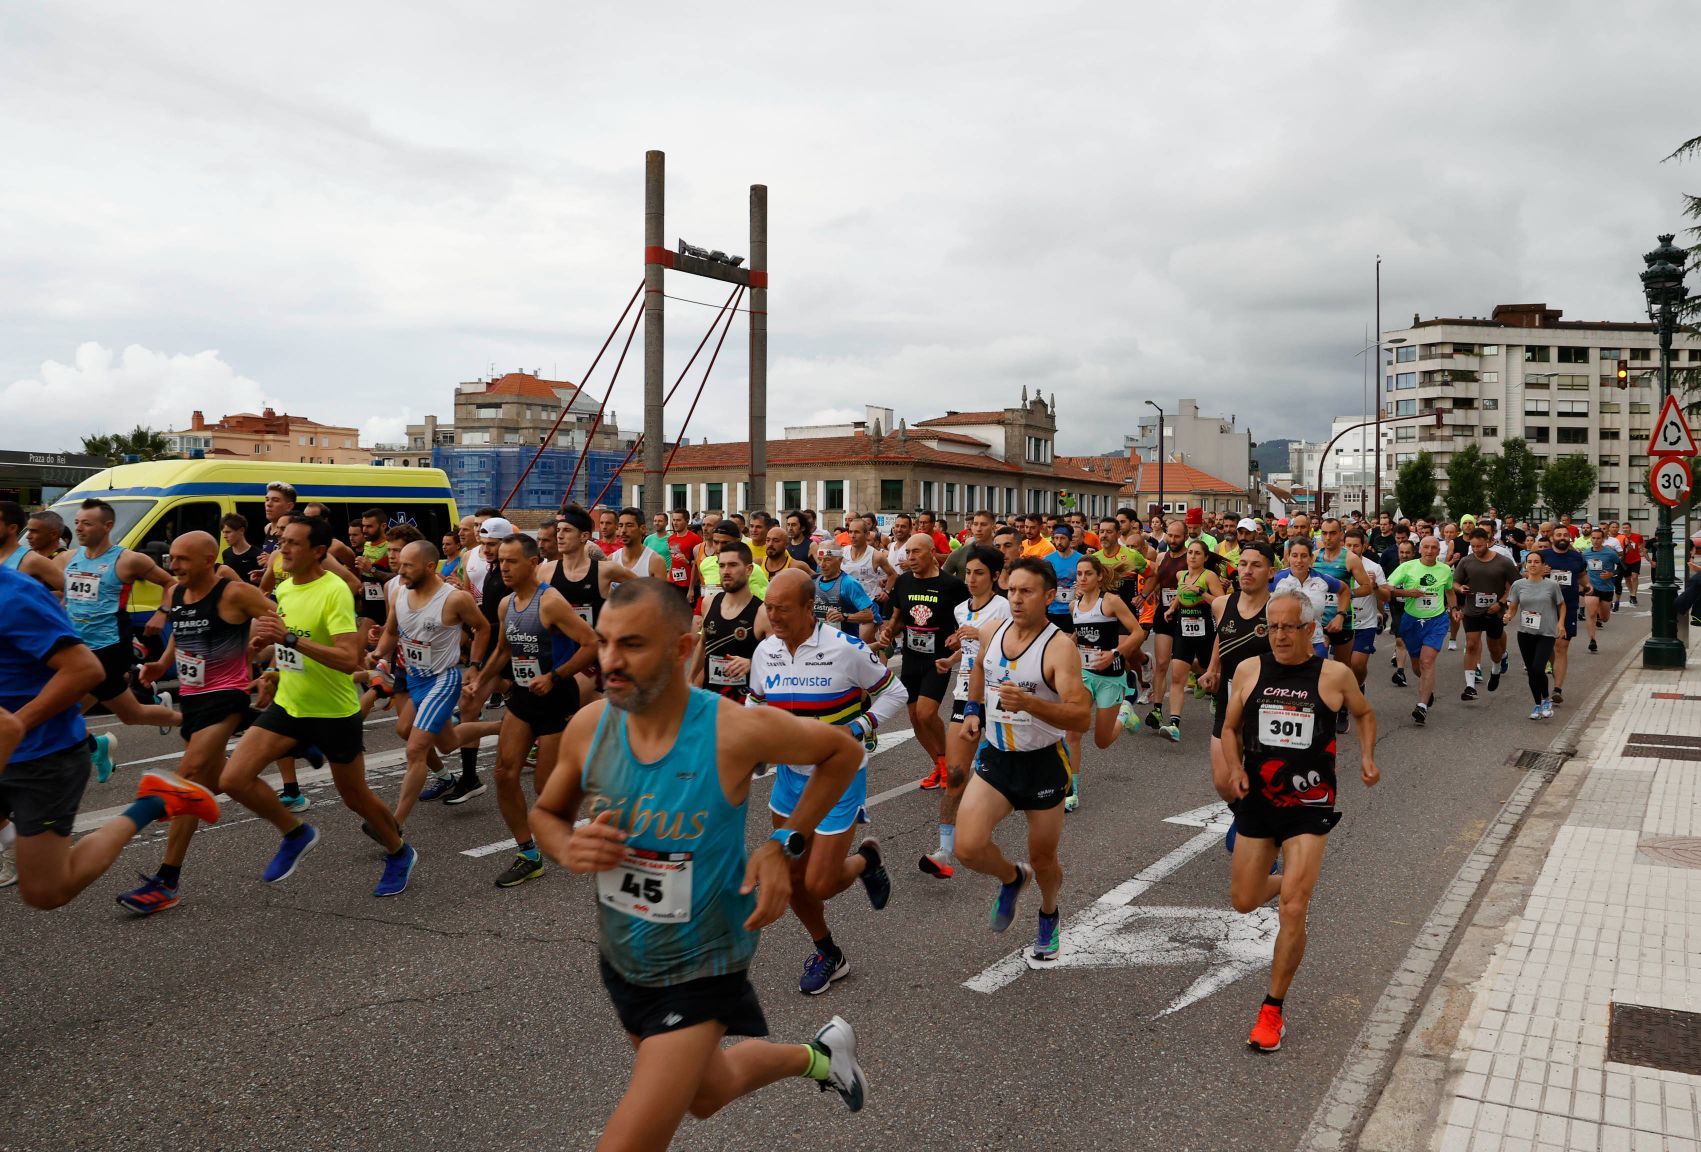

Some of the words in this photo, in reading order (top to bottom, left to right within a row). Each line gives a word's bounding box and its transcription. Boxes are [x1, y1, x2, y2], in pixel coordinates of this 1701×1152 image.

[29, 453, 45, 463] Praza
[46, 453, 54, 464] do
[56, 455, 66, 464] Rei
[1661, 473, 1683, 489] 30
[70, 581, 92, 594] 413
[179, 619, 209, 629] BARCO
[1185, 624, 1200, 632] 210
[912, 638, 927, 648] 54
[277, 647, 297, 664] 312
[406, 648, 423, 662] 161
[1084, 654, 1090, 663] 1
[782, 675, 832, 687] movistar
[1263, 686, 1308, 700] CARMA
[1270, 719, 1303, 737] 301
[620, 872, 664, 904] 45
